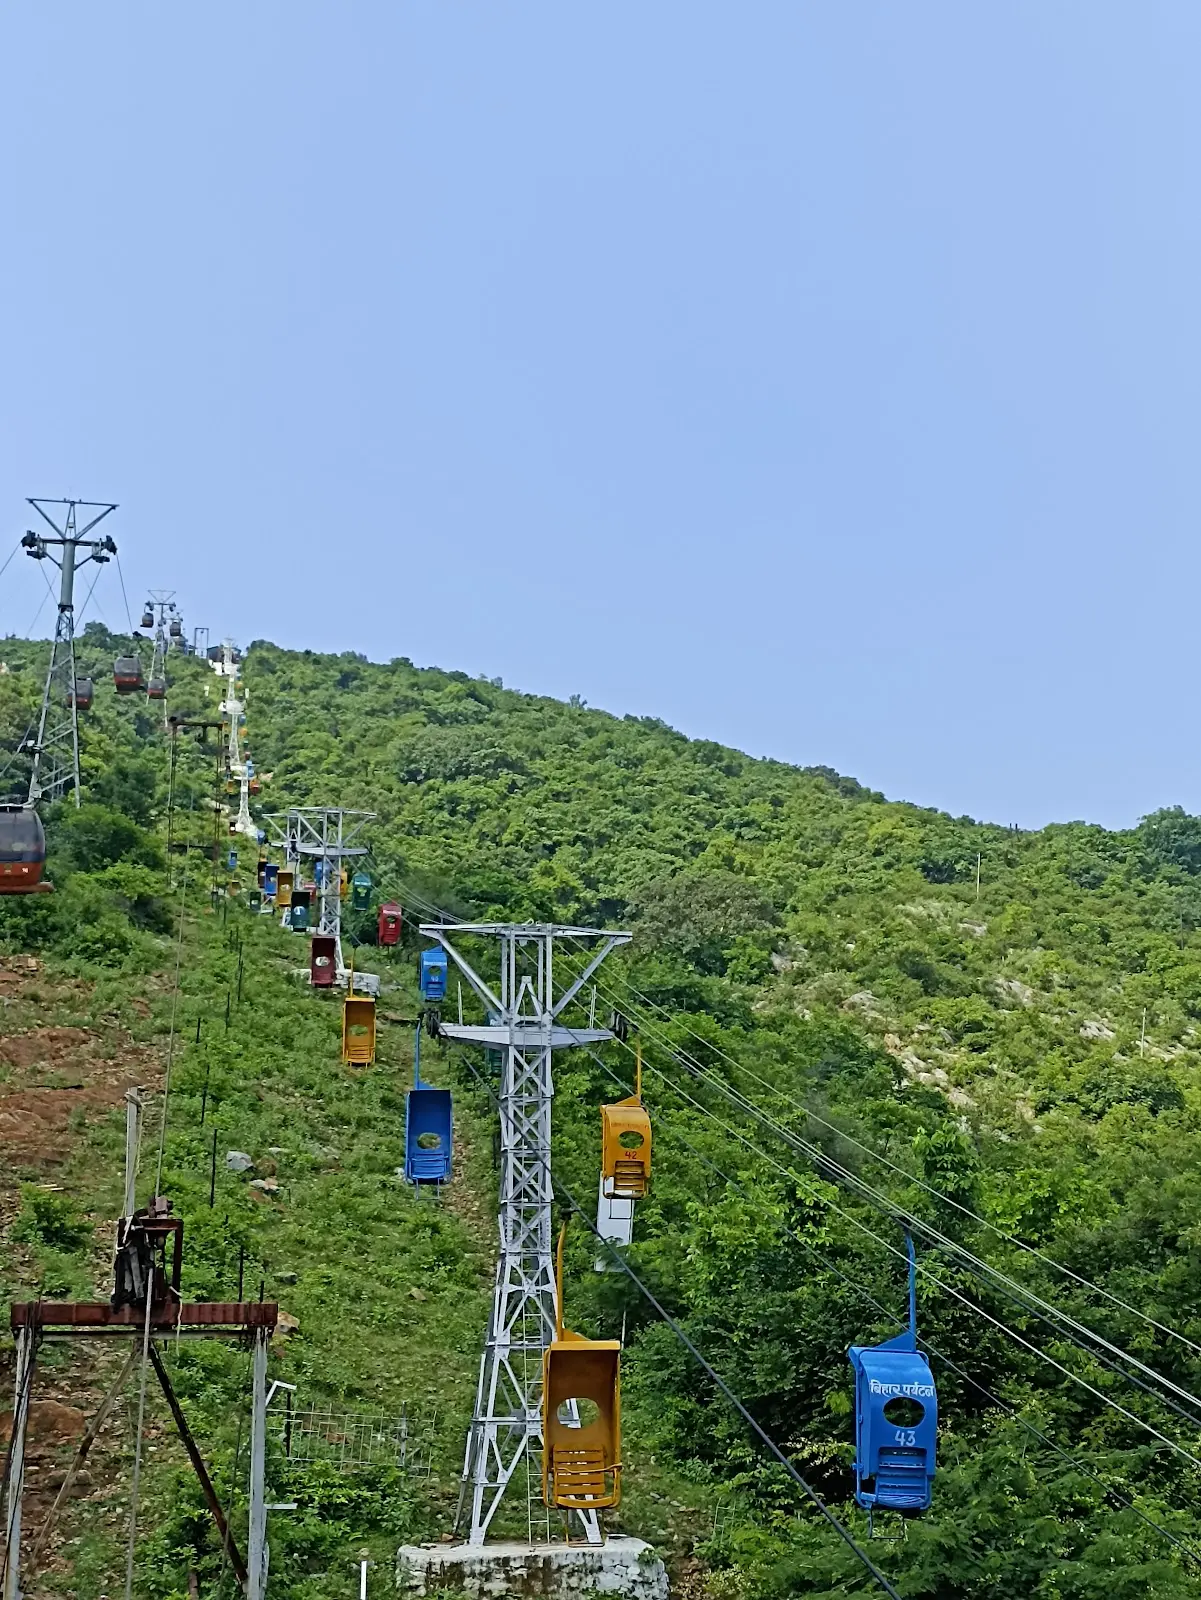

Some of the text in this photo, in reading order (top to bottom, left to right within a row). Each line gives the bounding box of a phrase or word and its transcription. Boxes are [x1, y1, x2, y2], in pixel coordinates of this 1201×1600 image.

[624, 1151, 637, 1160] 42
[870, 1379, 935, 1397] बिहार पर्यटन
[894, 1430, 916, 1447] 43
